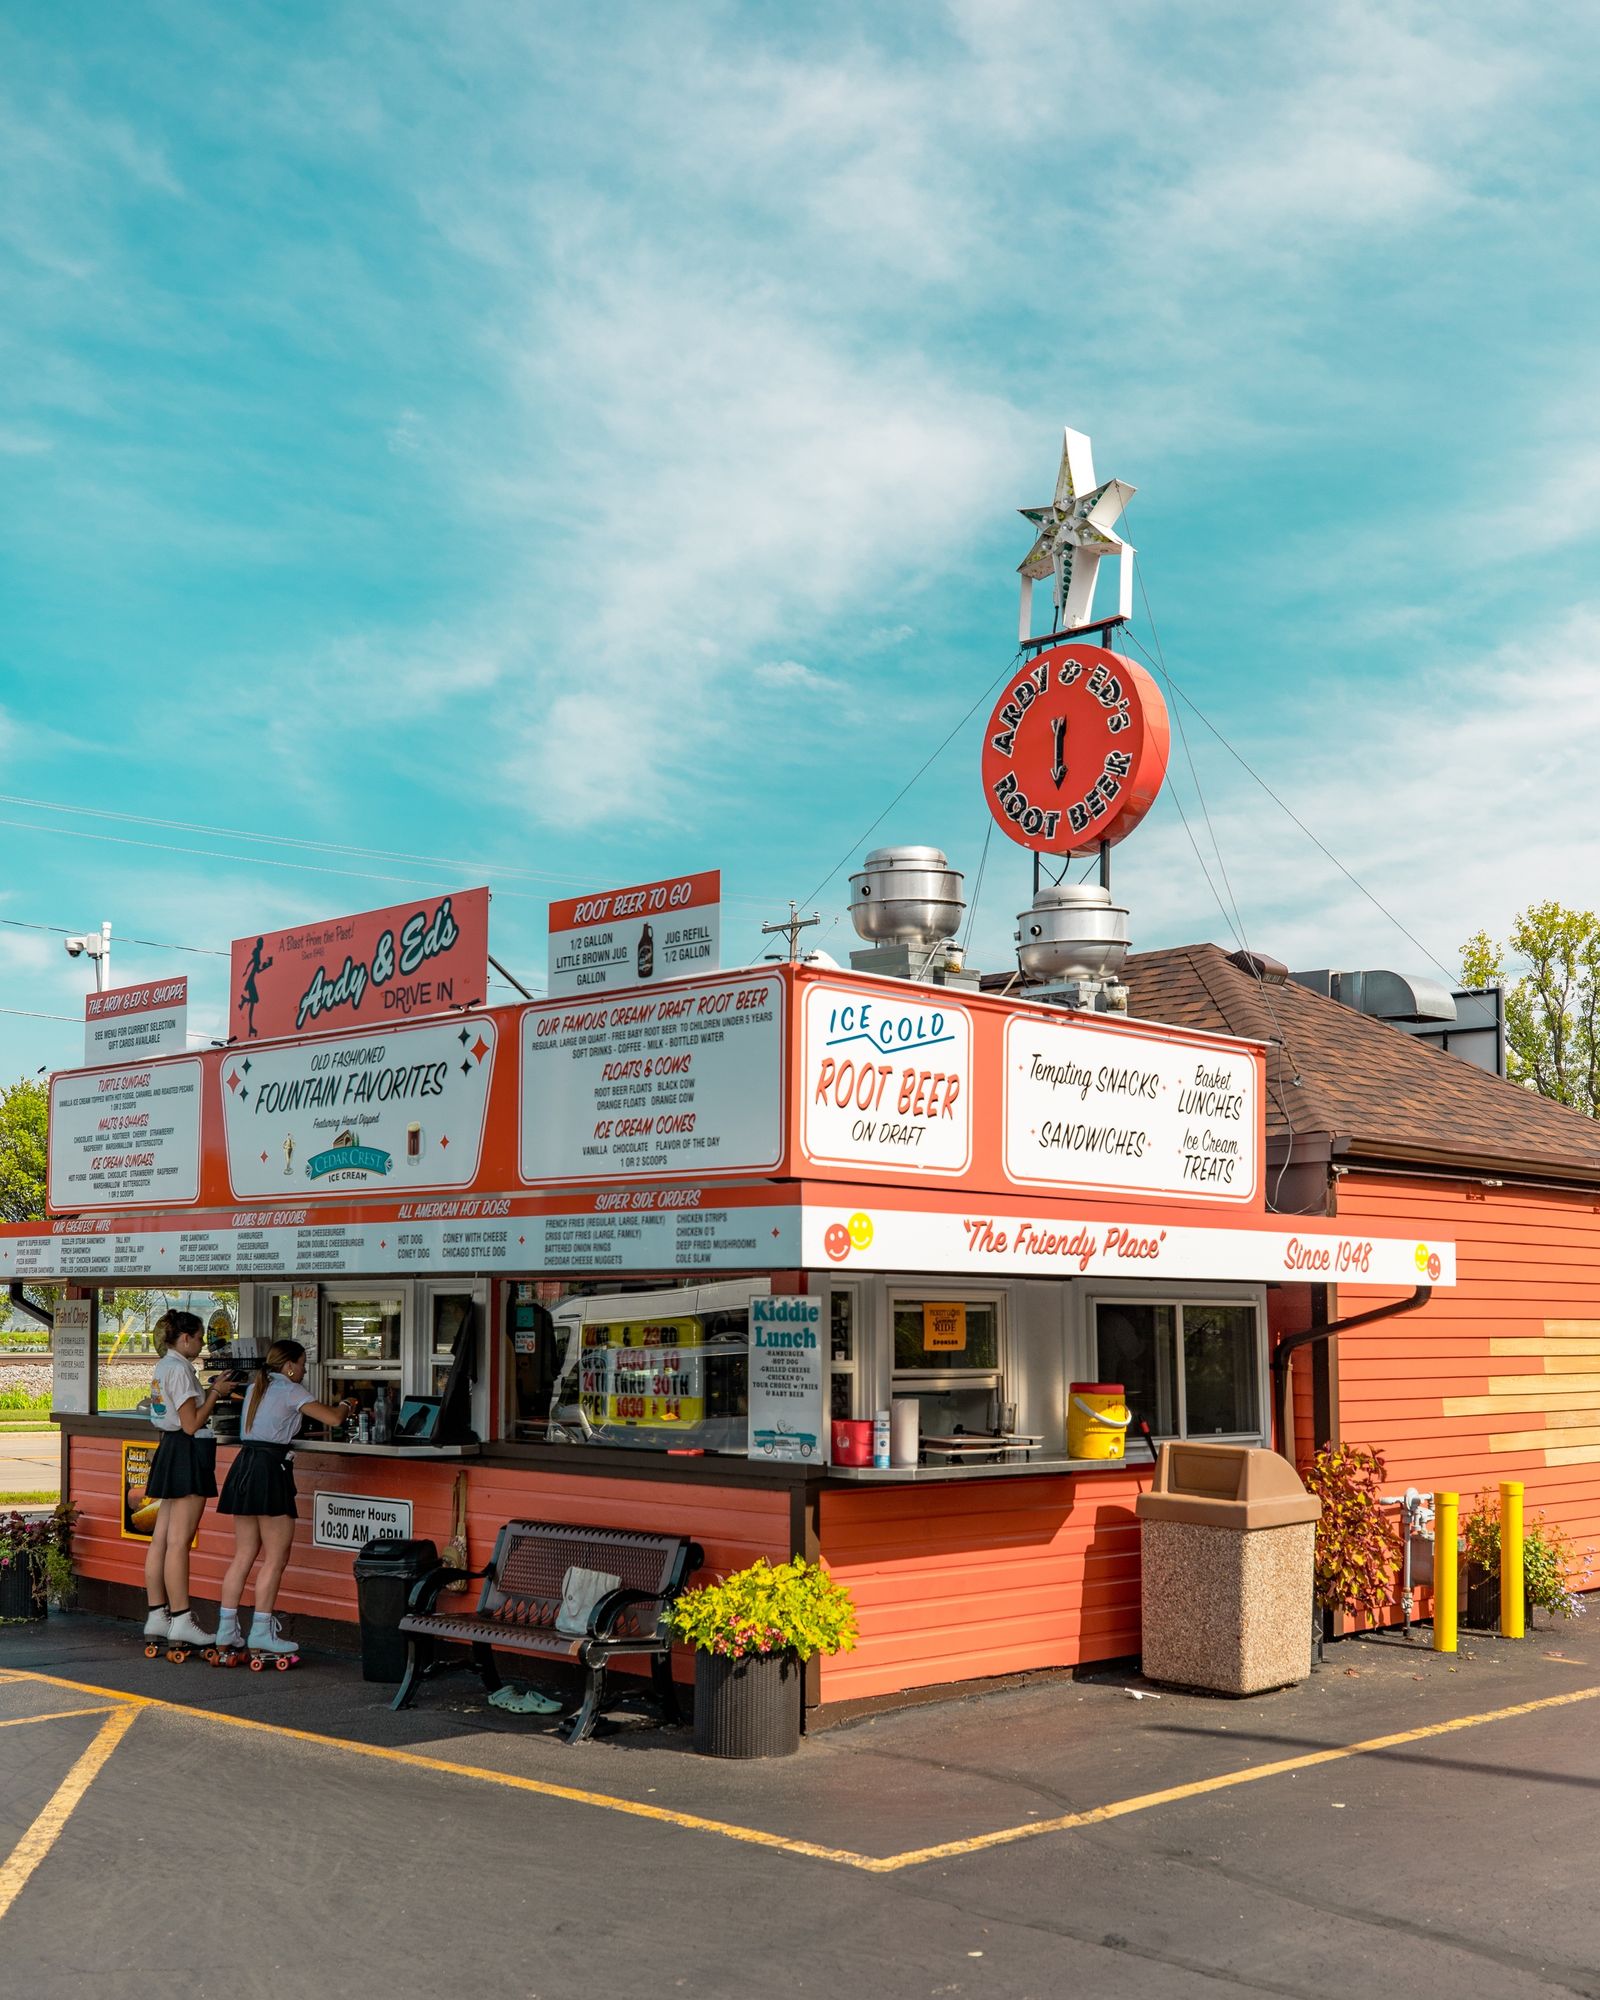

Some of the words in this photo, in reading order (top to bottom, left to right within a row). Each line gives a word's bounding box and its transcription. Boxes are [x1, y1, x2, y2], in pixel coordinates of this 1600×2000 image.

[991, 661, 1050, 758] ARDY
[1058, 658, 1082, 685] &
[1086, 663, 1131, 733] ED'S
[993, 770, 1061, 839] ROOT
[1067, 750, 1133, 834] BEER
[573, 898, 612, 924] ROOT
[612, 891, 647, 917] BEER
[648, 887, 667, 910] TO
[670, 882, 692, 906] GO
[279, 938, 285, 952] A
[287, 935, 304, 951] Blast
[305, 932, 322, 947] from
[323, 930, 334, 944] the
[570, 939, 582, 950] 1/2
[583, 932, 613, 948] GALLON
[665, 931, 680, 945] JUG
[682, 926, 710, 942] REFILL
[295, 956, 367, 1030] Ardy
[371, 929, 394, 986] &
[399, 897, 459, 976] Ed's
[556, 954, 581, 969] LITTLE
[582, 949, 611, 965] BROWN
[612, 946, 627, 960] JUG
[664, 951, 677, 963] 1/2
[678, 945, 711, 961] GALLON
[576, 971, 606, 986] GALLON
[88, 998, 103, 1015] THE
[103, 994, 124, 1012] ARDY
[130, 990, 150, 1008] ED'S
[152, 983, 187, 1005] SHOPPE
[383, 982, 431, 1013] DRIVE
[437, 978, 453, 1001] IN
[537, 1017, 560, 1037] OUR
[561, 1010, 608, 1033] FAMOUS
[610, 1004, 656, 1027] CREAMY
[658, 998, 695, 1021] DRAFT
[697, 992, 734, 1015] ROOT
[736, 987, 769, 1010] BEER
[95, 1031, 104, 1041] SEE
[104, 1028, 117, 1039] MENU
[118, 1026, 127, 1037] FOR
[128, 1023, 150, 1036] CURRENT
[150, 1019, 176, 1032] SELECTION
[560, 1037, 577, 1048] LARGE
[578, 1036, 587, 1045] OR
[588, 1033, 607, 1044] QUART
[612, 1031, 627, 1041] FREE
[627, 1028, 643, 1040] BABY
[644, 1026, 660, 1037] ROOT
[661, 1024, 677, 1035] BEER
[680, 1023, 689, 1032] TO
[690, 1018, 721, 1031] CHILDREN
[722, 1015, 744, 1027] UNDER
[752, 1011, 773, 1023] YEARS
[830, 1004, 872, 1033] ICE
[880, 1013, 944, 1044] COLD
[108, 1040, 118, 1050] GIFT
[119, 1038, 134, 1049] CARDS
[135, 1033, 160, 1046] AVAILABLE
[572, 1048, 588, 1060] SOFT
[589, 1045, 612, 1057] DRINKS
[618, 1042, 641, 1054] COFFEE
[647, 1039, 663, 1050] MILK
[670, 1034, 698, 1048] BOTTLED
[700, 1031, 724, 1043] WATER
[311, 1054, 330, 1072] OLD
[331, 1046, 385, 1069] FASHIONED
[601, 1058, 643, 1081] FLOATS
[644, 1059, 653, 1078] &
[654, 1054, 691, 1076] COWS
[255, 1074, 342, 1115] FOUNTAIN
[343, 1061, 447, 1105] FAVORITES
[1030, 1053, 1092, 1101] Tempting
[1095, 1066, 1159, 1100] SNACKS
[1194, 1064, 1231, 1091] Basket
[815, 1057, 893, 1111] ROOT
[897, 1067, 960, 1121] BEER
[1178, 1088, 1242, 1121] LUNCHES
[313, 1118, 340, 1132] Featuring
[341, 1114, 358, 1126] Hand
[358, 1112, 380, 1127] Dipped
[593, 1120, 614, 1140] ICE
[614, 1117, 654, 1138] CREAM
[655, 1113, 696, 1134] CONES
[852, 1120, 877, 1142] ON
[879, 1123, 926, 1146] DRAFT
[582, 1145, 608, 1156] VANILLA
[612, 1142, 648, 1154] CHOCOLATE
[656, 1139, 681, 1151] FLAVOR
[682, 1138, 691, 1149] OF
[693, 1137, 705, 1148] THE
[707, 1136, 720, 1147] DAY
[1038, 1120, 1146, 1158] SANDWICHES
[1182, 1127, 1199, 1150] Ice
[1201, 1129, 1239, 1155] Cream
[91, 1158, 102, 1170] ICE
[103, 1155, 123, 1170] CREAM
[124, 1152, 154, 1168] SUNDAES
[315, 1151, 348, 1173] CEDAR
[350, 1149, 381, 1168] CREST
[1183, 1155, 1235, 1184] TREATS
[328, 1174, 340, 1183] ICE
[341, 1171, 367, 1181] CREAM
[398, 1204, 414, 1219] ALL
[414, 1201, 460, 1218] AMERICAN
[460, 1200, 480, 1216] HOT
[481, 1199, 511, 1215] DOGS
[594, 1193, 630, 1210] SUPER
[631, 1191, 657, 1209] SIDE
[657, 1189, 702, 1208] ORDERS
[52, 1221, 65, 1234] OUR
[66, 1220, 95, 1233] GREATEST
[95, 1219, 111, 1232] HITS
[231, 1212, 256, 1227] OLDIES
[257, 1212, 272, 1225] BUT
[272, 1210, 307, 1225] GOODIES
[676, 1214, 703, 1223] CHICKEN
[704, 1212, 727, 1223] STRIPS
[398, 1235, 410, 1245] HOT
[410, 1234, 423, 1244] DOG
[442, 1233, 463, 1244] CONEY
[465, 1232, 481, 1243] WITH
[482, 1231, 508, 1242] CHEESE
[397, 1249, 416, 1259] CONEY
[417, 1248, 430, 1258] DOG
[441, 1247, 470, 1258] CHICAGO
[471, 1246, 490, 1257] STYLE
[492, 1246, 506, 1257] DOG
[1283, 1237, 1330, 1271] Since
[1335, 1240, 1373, 1273] 1948
[753, 1300, 819, 1323] Kiddie
[754, 1326, 817, 1349] Lunch
[328, 1503, 365, 1519] Summer
[368, 1507, 397, 1523] Hours
[320, 1520, 349, 1540] 10:30
[352, 1524, 369, 1542] AM
